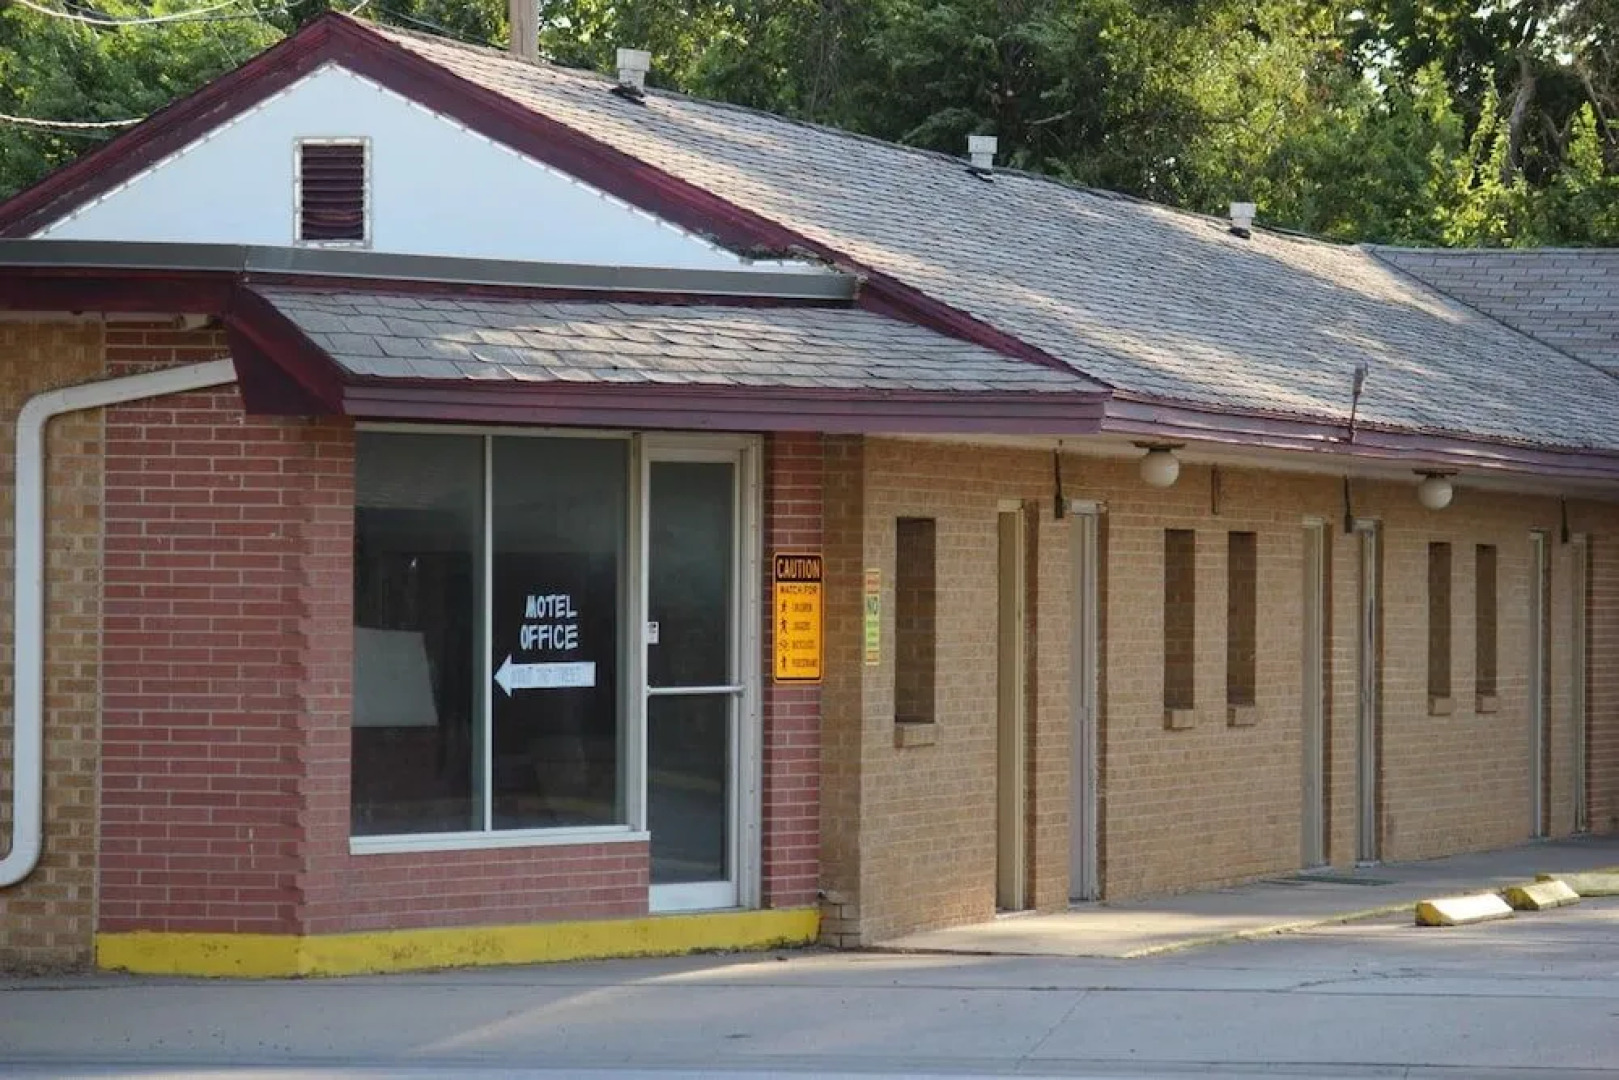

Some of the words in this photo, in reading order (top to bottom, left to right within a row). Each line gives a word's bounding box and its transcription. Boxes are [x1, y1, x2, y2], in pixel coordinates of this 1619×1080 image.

[778, 559, 820, 579] CAUTION
[780, 585, 802, 595] WATCH
[804, 585, 817, 595] FOR
[525, 594, 578, 619] MOTEL
[520, 624, 579, 651] OFFICE
